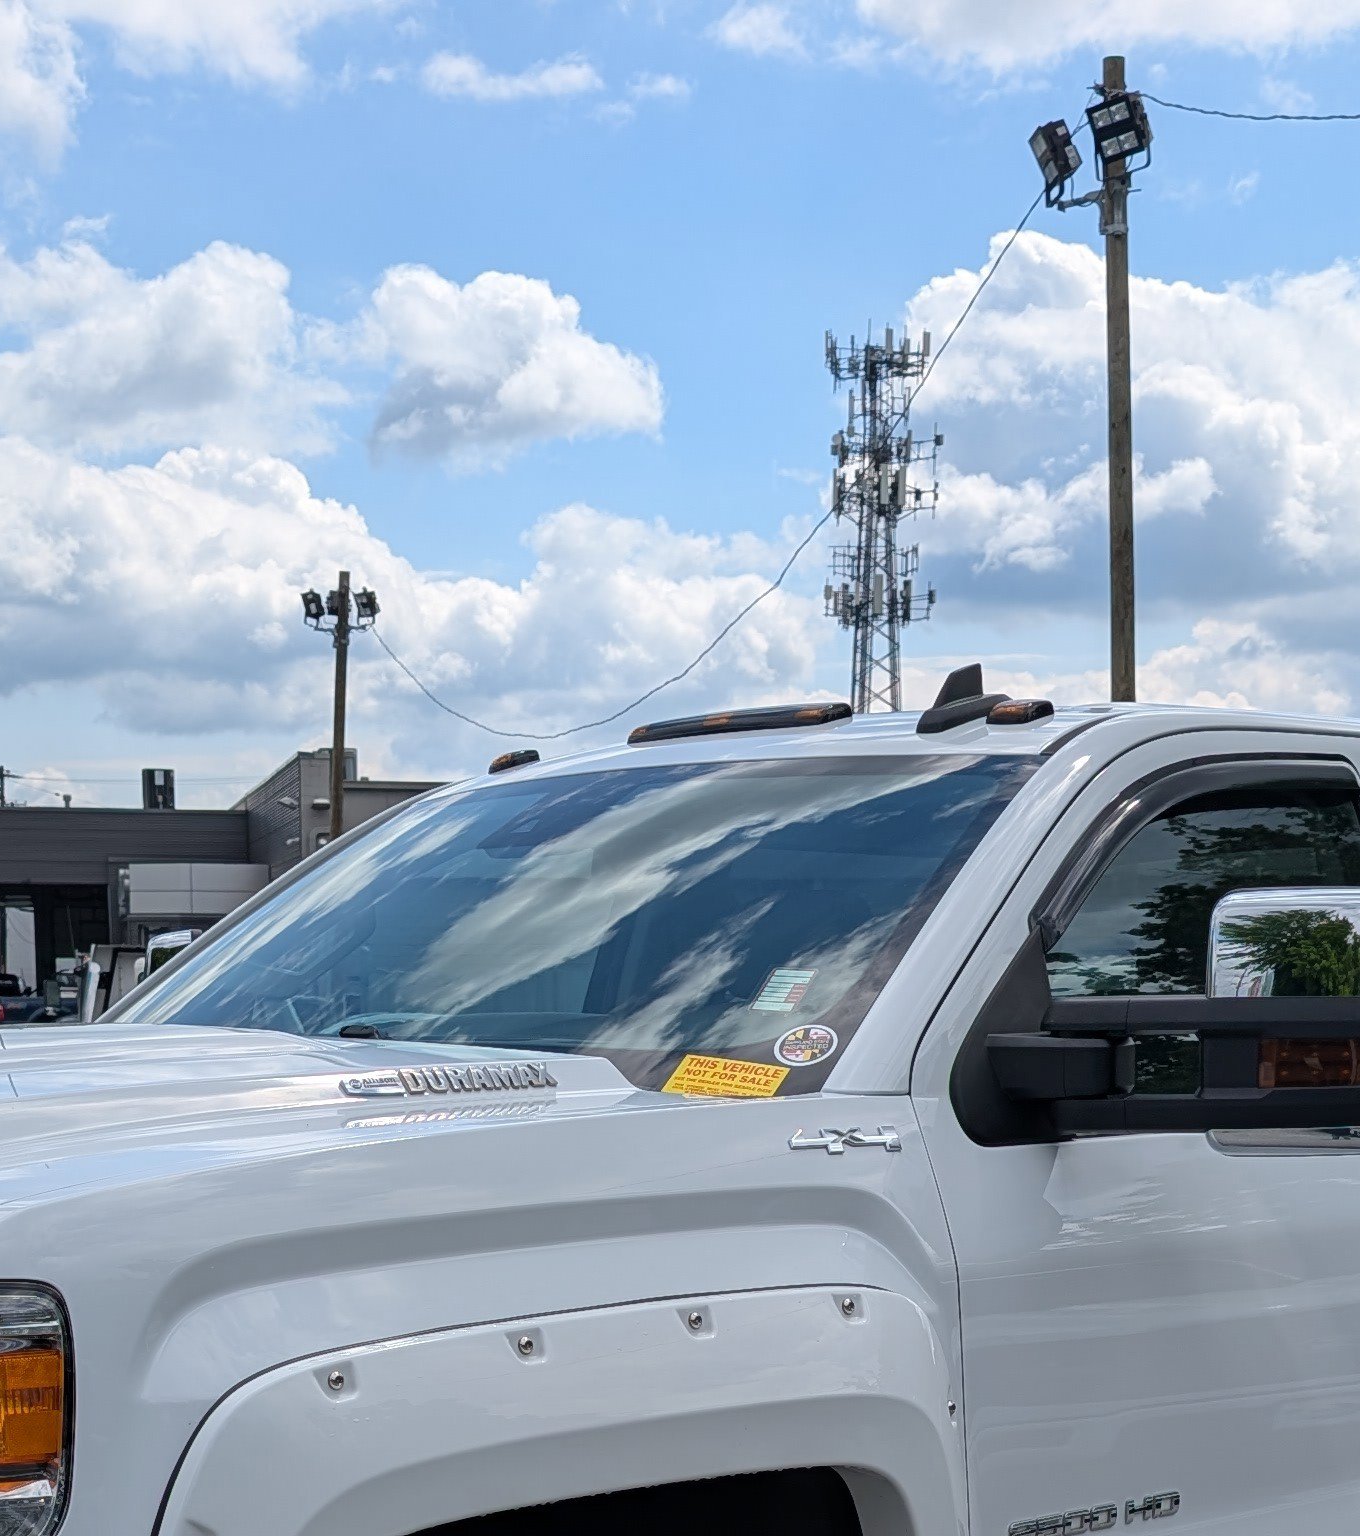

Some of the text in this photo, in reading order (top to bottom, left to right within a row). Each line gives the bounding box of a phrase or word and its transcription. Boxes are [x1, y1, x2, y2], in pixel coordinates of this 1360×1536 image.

[397, 1062, 558, 1096] DURAMAX
[683, 1067, 774, 1088] NOT FOR SALE
[687, 1057, 783, 1079] THIS VEHICLE
[1124, 1490, 1181, 1525] HD
